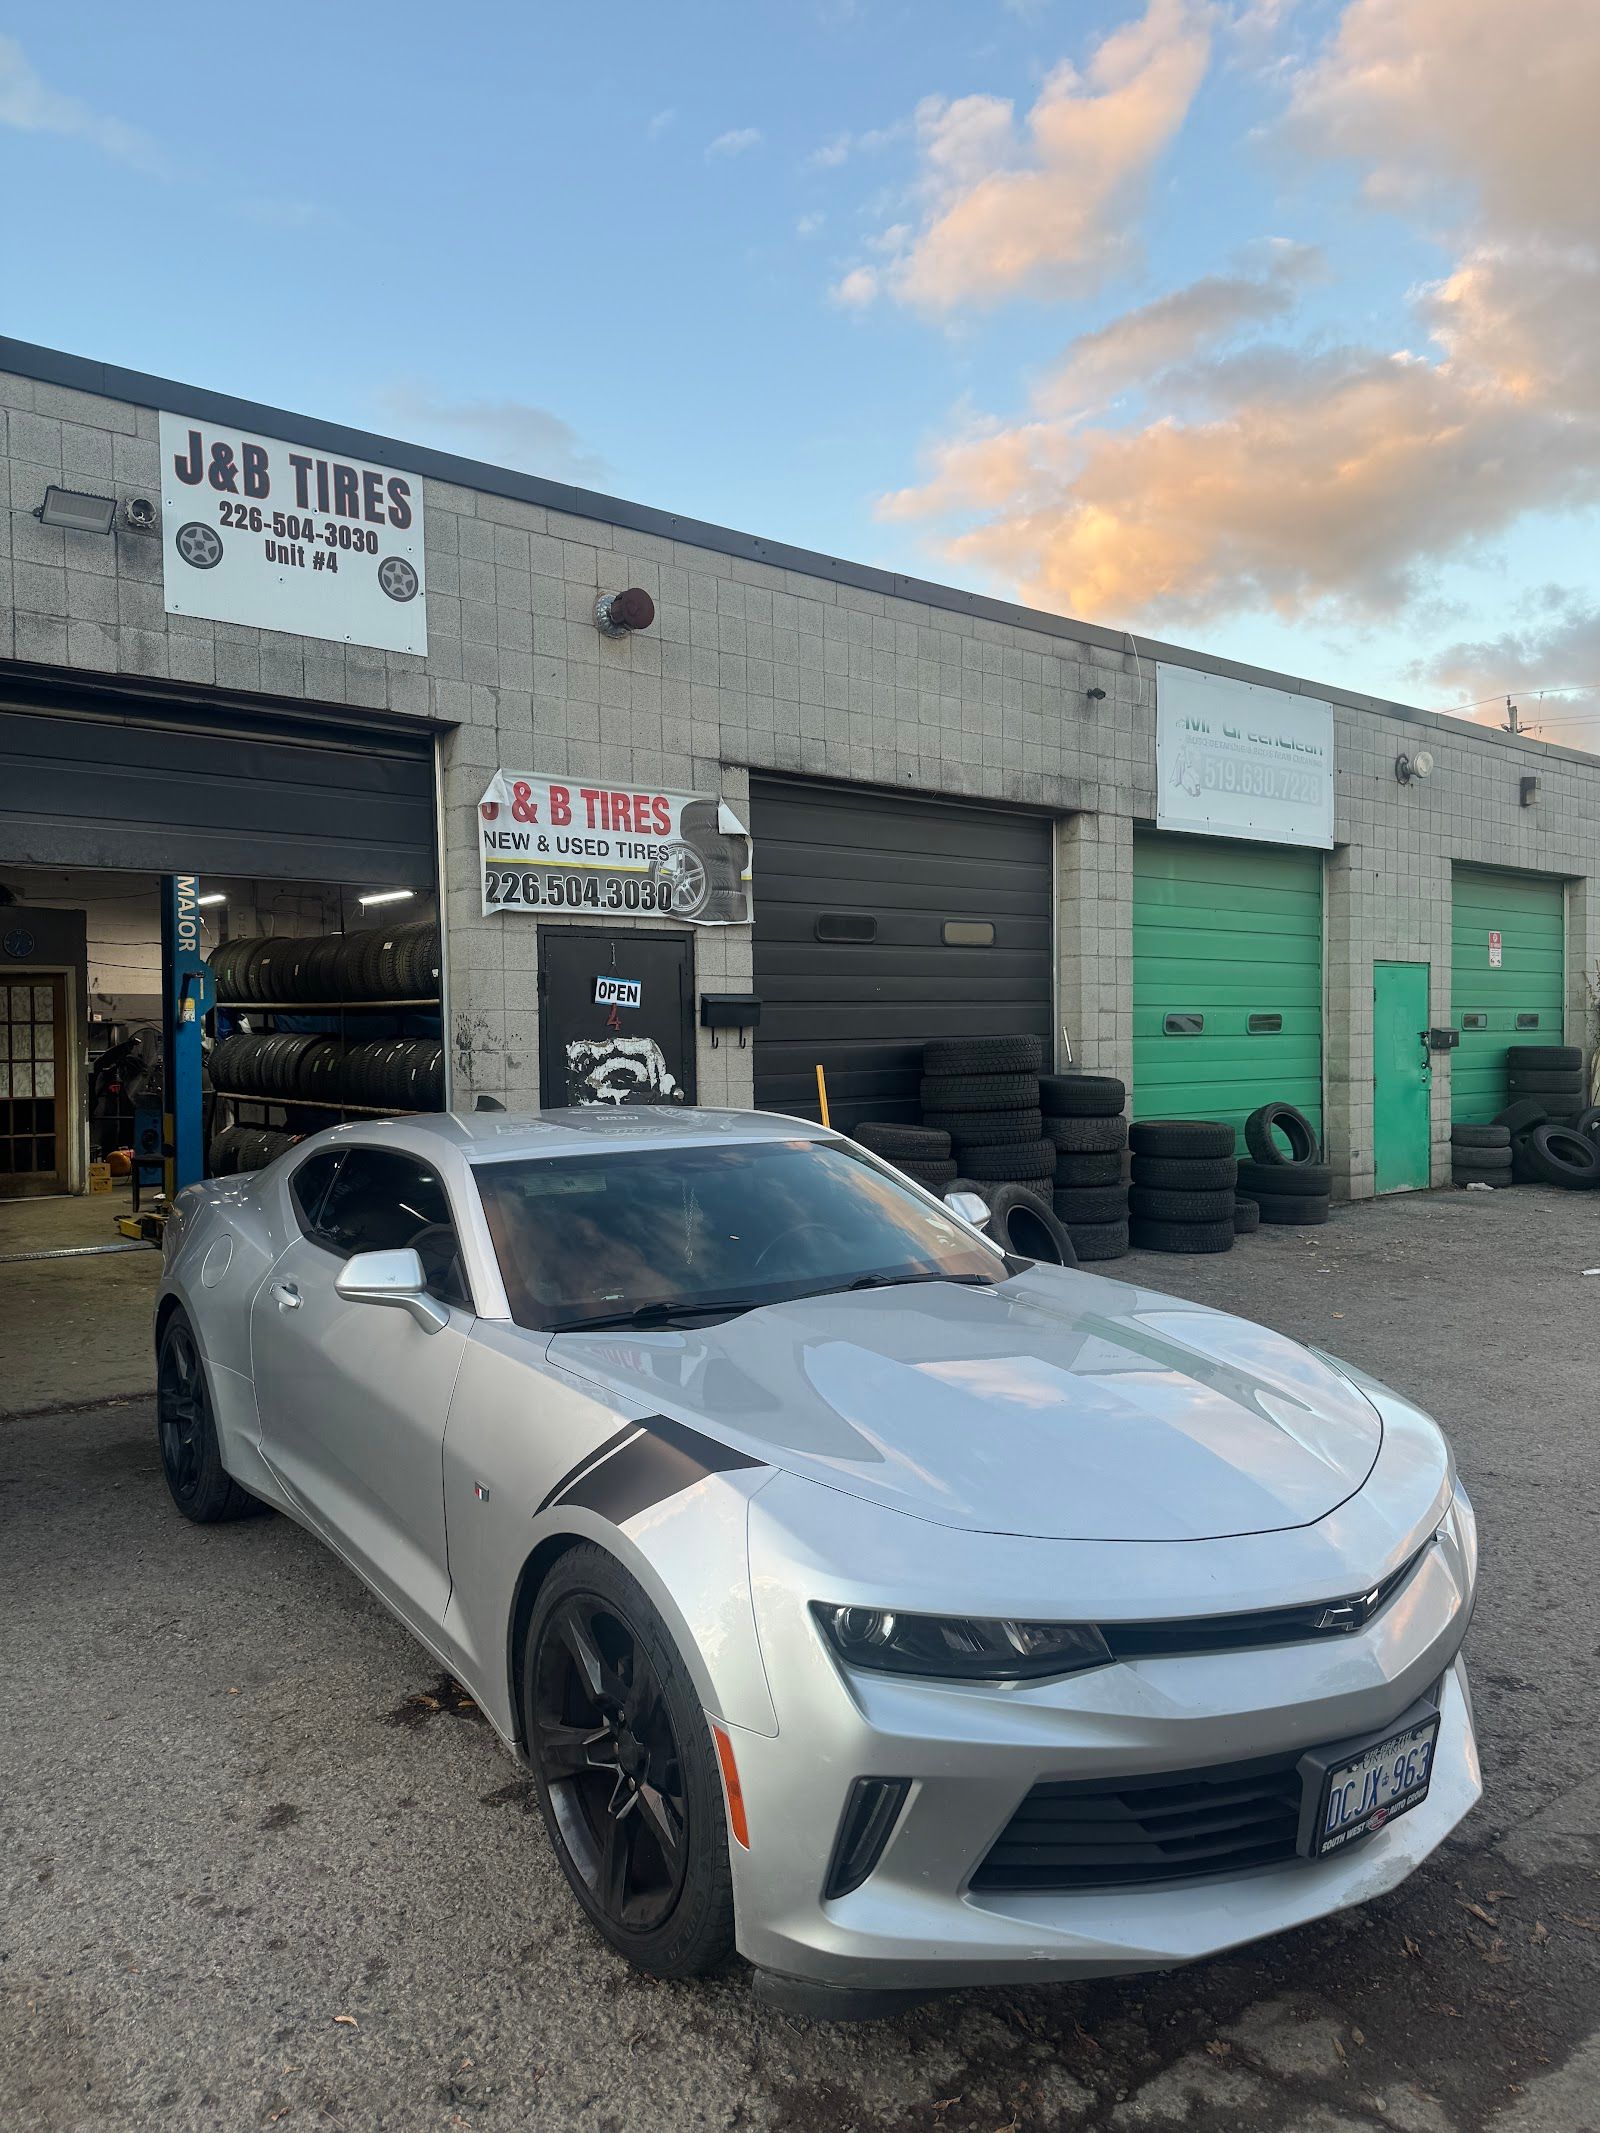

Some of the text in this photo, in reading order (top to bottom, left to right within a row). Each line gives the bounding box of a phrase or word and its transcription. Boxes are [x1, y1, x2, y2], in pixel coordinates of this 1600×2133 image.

[174, 430, 412, 530] J&B TIRES
[219, 500, 379, 555] 226-504-3030
[265, 539, 339, 574] Unit #4
[511, 781, 538, 824] &
[549, 785, 572, 826] B
[580, 789, 672, 836] TIRES
[484, 830, 670, 861] NEW & USED TIRES
[485, 871, 673, 911] 226.504.3030
[177, 876, 197, 951] MAJOR
[598, 981, 638, 1002] OPEN
[606, 1003, 622, 1030] 4
[1326, 1764, 1383, 1832] DCJX
[1391, 1741, 1432, 1797] 963
[1321, 1833, 1346, 1853] SOUTH
[1346, 1822, 1366, 1841] WEST
